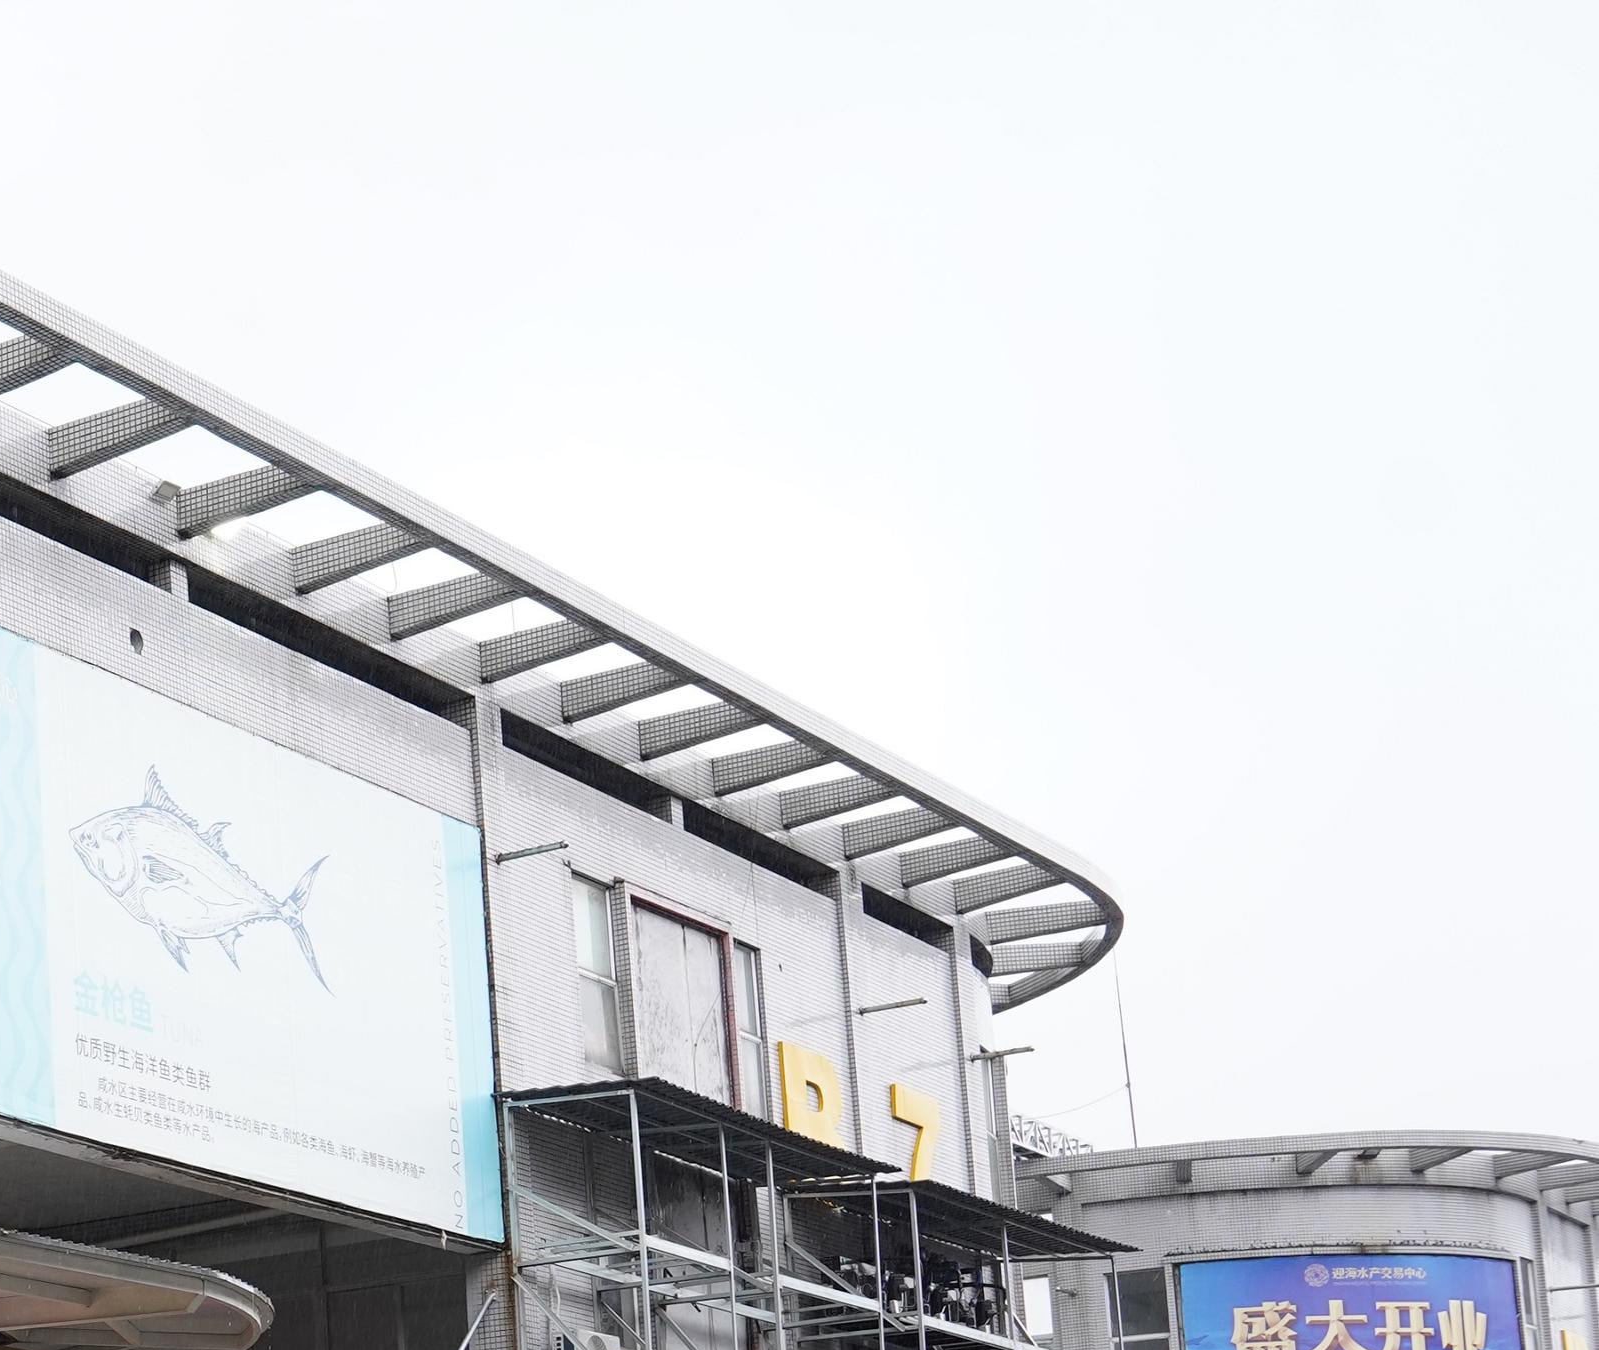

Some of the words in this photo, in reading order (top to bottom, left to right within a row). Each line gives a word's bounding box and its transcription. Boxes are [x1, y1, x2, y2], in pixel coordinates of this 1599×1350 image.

[431, 838, 455, 1063] PRESERVATIVES
[73, 969, 155, 1033] 金枪鱼
[75, 1032, 213, 1093] 优质野生海洋鱼类鱼群
[447, 1075, 462, 1178] ADDED
[452, 1190, 466, 1229] NO
[1331, 1266, 1427, 1281] 迎海水产交易中心
